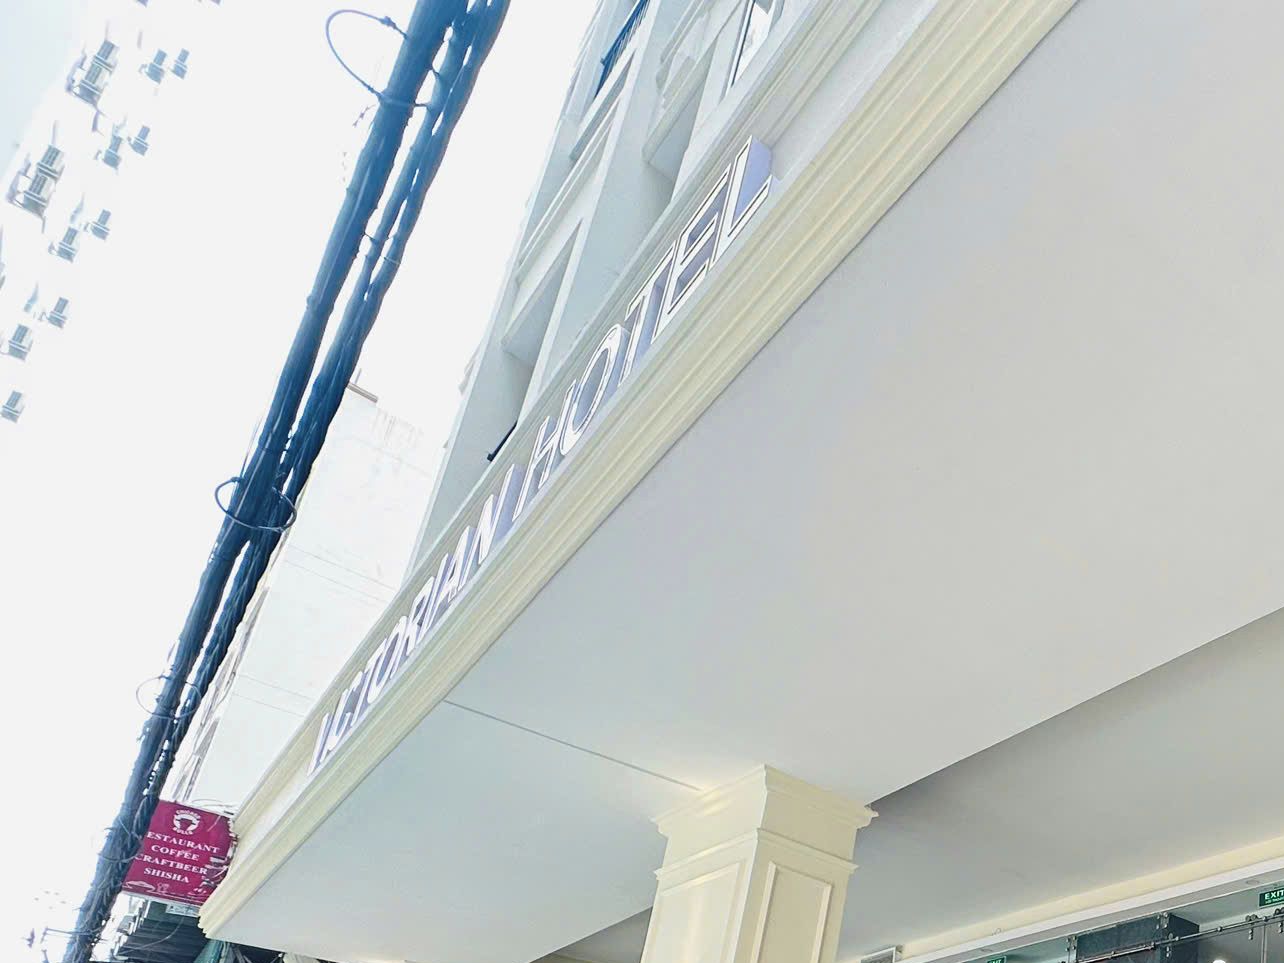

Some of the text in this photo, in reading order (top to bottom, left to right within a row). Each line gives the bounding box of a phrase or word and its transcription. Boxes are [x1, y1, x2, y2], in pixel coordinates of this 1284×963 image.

[512, 134, 773, 523] HOTEL
[146, 831, 220, 854] ESTAURANT
[151, 844, 200, 862] COFFEE
[143, 867, 190, 883] SHISHA
